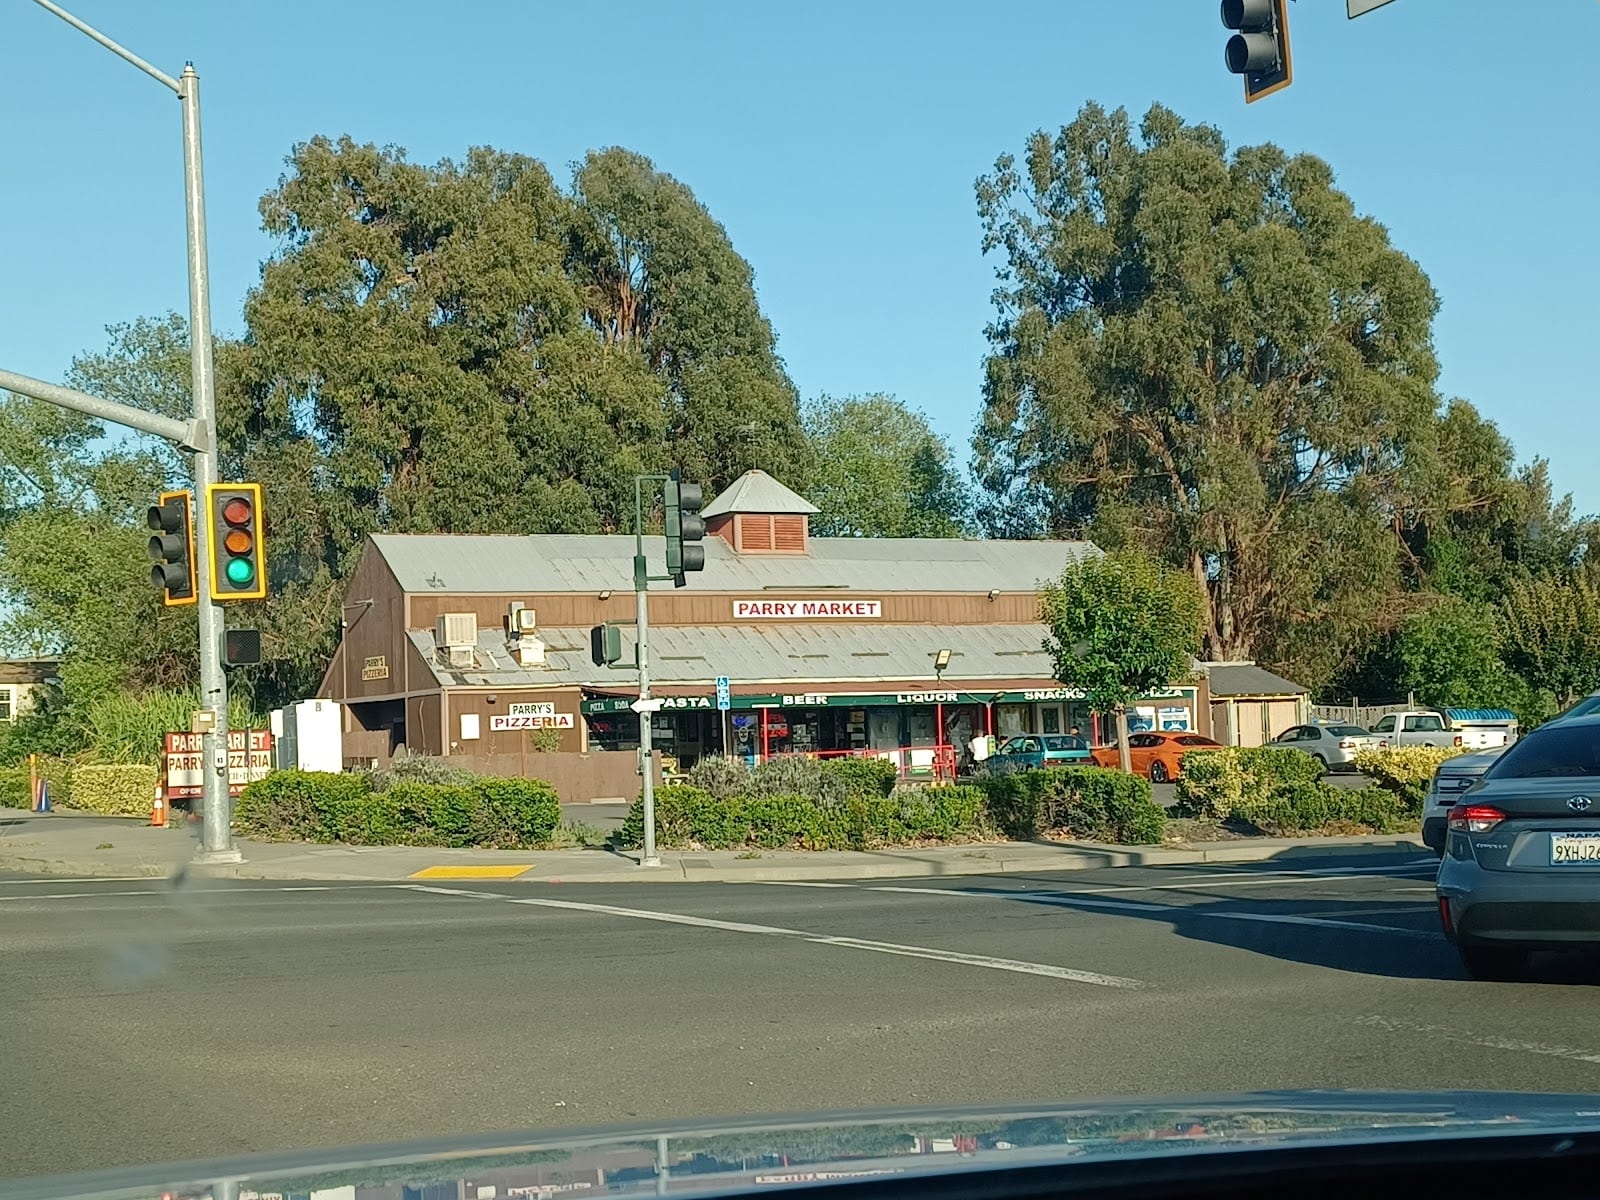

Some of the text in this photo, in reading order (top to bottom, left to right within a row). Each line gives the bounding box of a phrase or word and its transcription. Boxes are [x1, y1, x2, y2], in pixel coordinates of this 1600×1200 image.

[738, 603, 877, 615] PARRY MARKET
[783, 696, 828, 705] BEER
[897, 692, 958, 703] LIQUOR
[1023, 689, 1086, 701] SNACKS
[513, 704, 552, 715] PARRY'S
[589, 702, 605, 712] PIZZA
[495, 716, 569, 728] PIZZERIA
[172, 733, 203, 752] PARR
